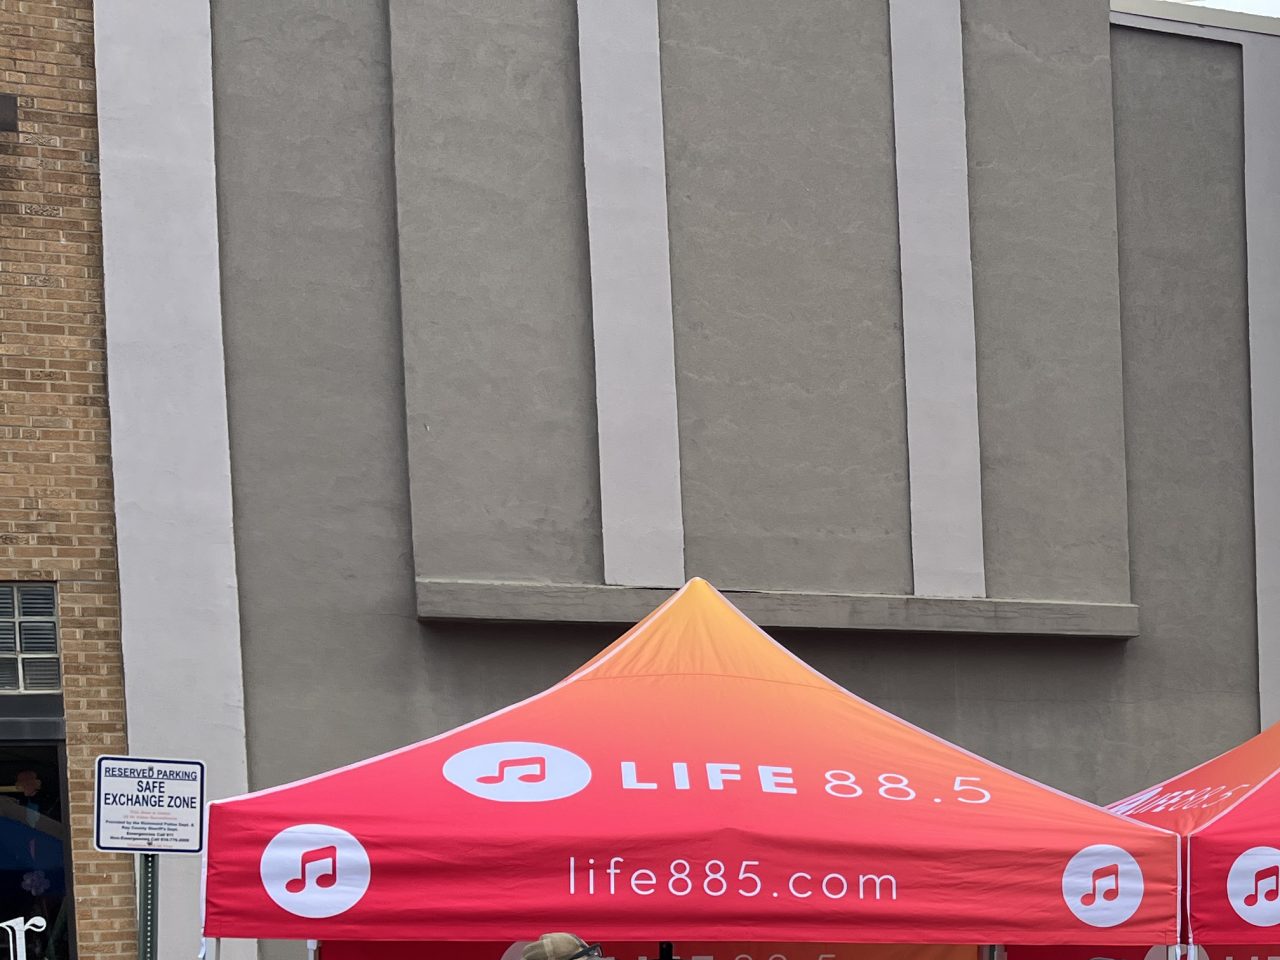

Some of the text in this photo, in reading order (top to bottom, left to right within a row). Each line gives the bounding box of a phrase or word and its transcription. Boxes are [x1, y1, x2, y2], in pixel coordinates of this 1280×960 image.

[104, 767, 197, 780] RESERVED PARKING
[137, 780, 165, 793] SAFE
[621, 761, 991, 804] LIFE 88.5
[104, 793, 196, 808] EXCHANGE ZONE
[569, 857, 897, 900] life885.com
